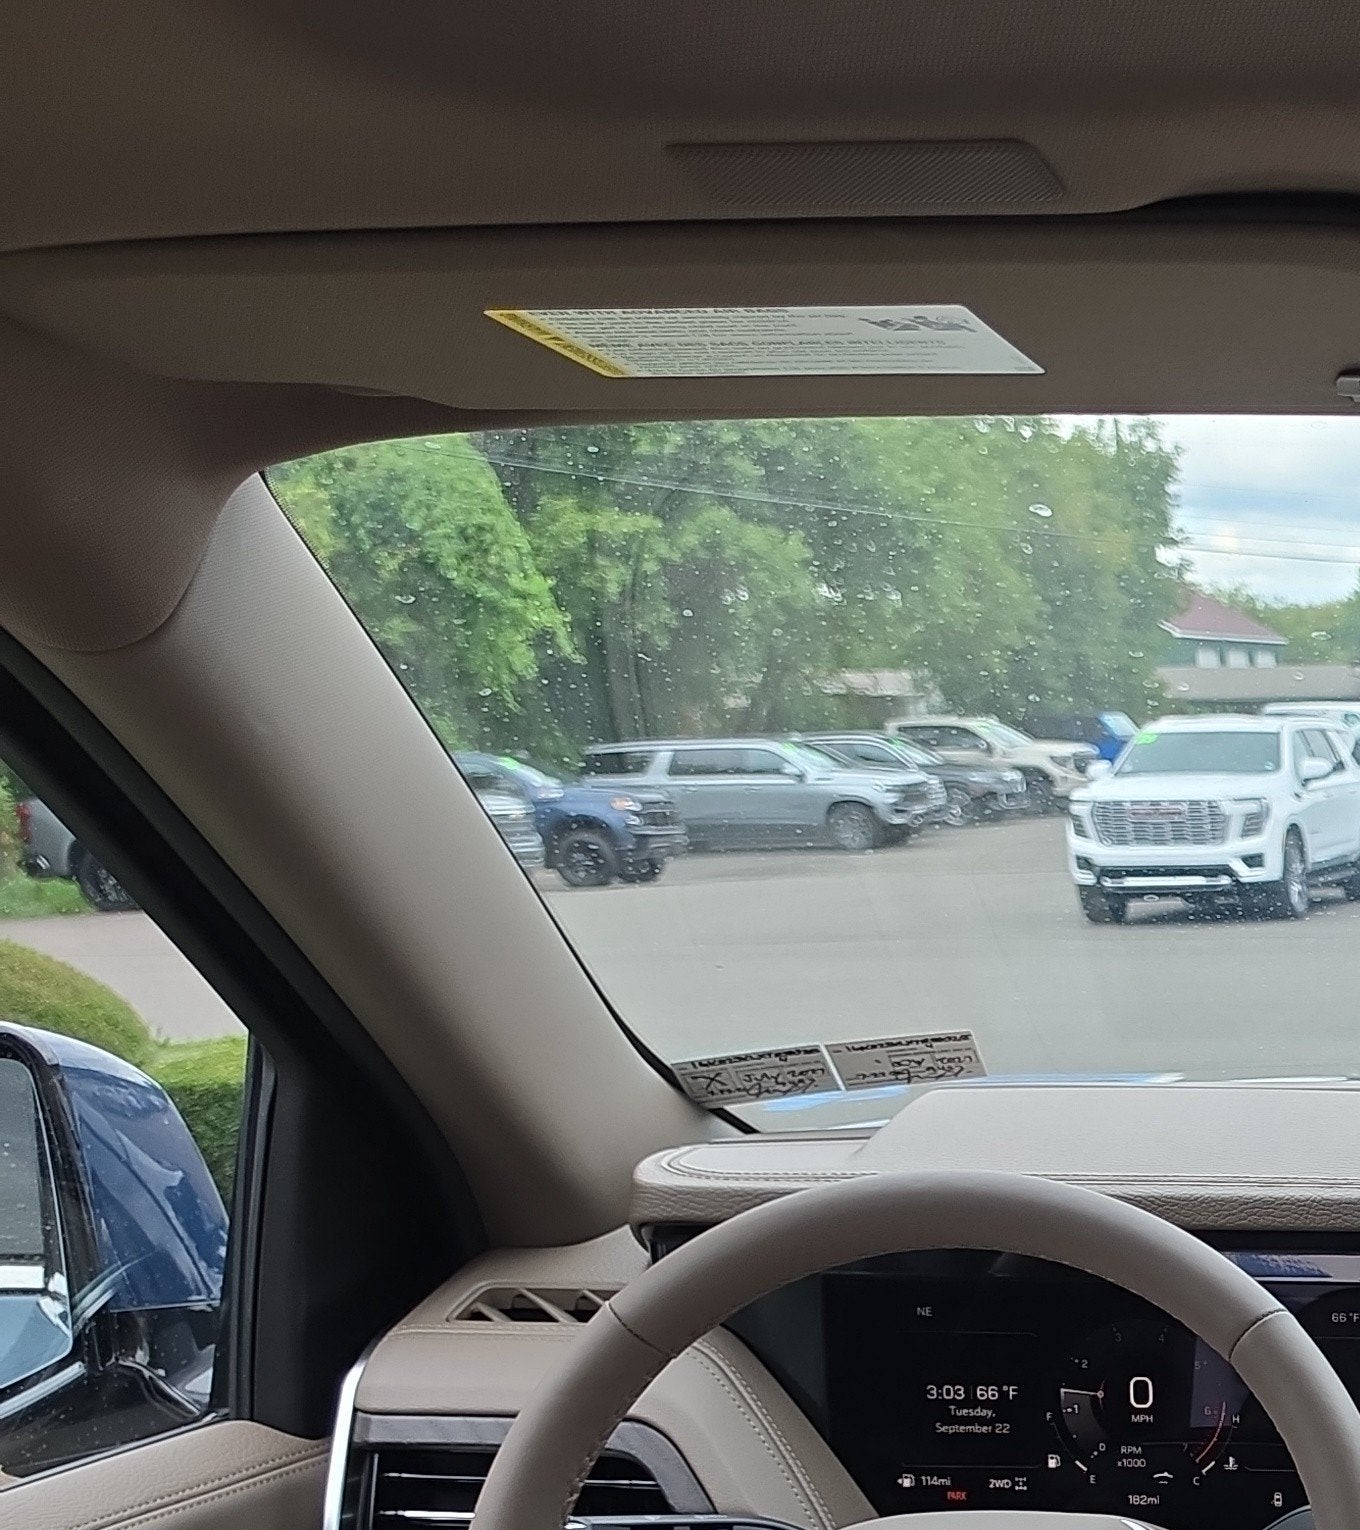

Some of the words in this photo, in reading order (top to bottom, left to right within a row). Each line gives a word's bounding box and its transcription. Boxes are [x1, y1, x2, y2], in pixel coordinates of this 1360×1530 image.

[916, 1306, 933, 1317] NE
[1331, 1312, 1347, 1323] 66
[926, 1384, 966, 1400] 3:03
[976, 1385, 999, 1400] 66
[1129, 1376, 1154, 1409] 0
[948, 1405, 997, 1418] Tuesday,
[1131, 1414, 1154, 1424] MPH
[935, 1422, 993, 1435] September
[995, 1423, 1011, 1434] 22
[1120, 1446, 1142, 1455] RPM
[1117, 1459, 1147, 1468] x1000
[920, 1476, 951, 1486] 114mi
[988, 1479, 1012, 1488] 2WD
[947, 1491, 967, 1501] PARK
[1128, 1495, 1161, 1506] 182mi
